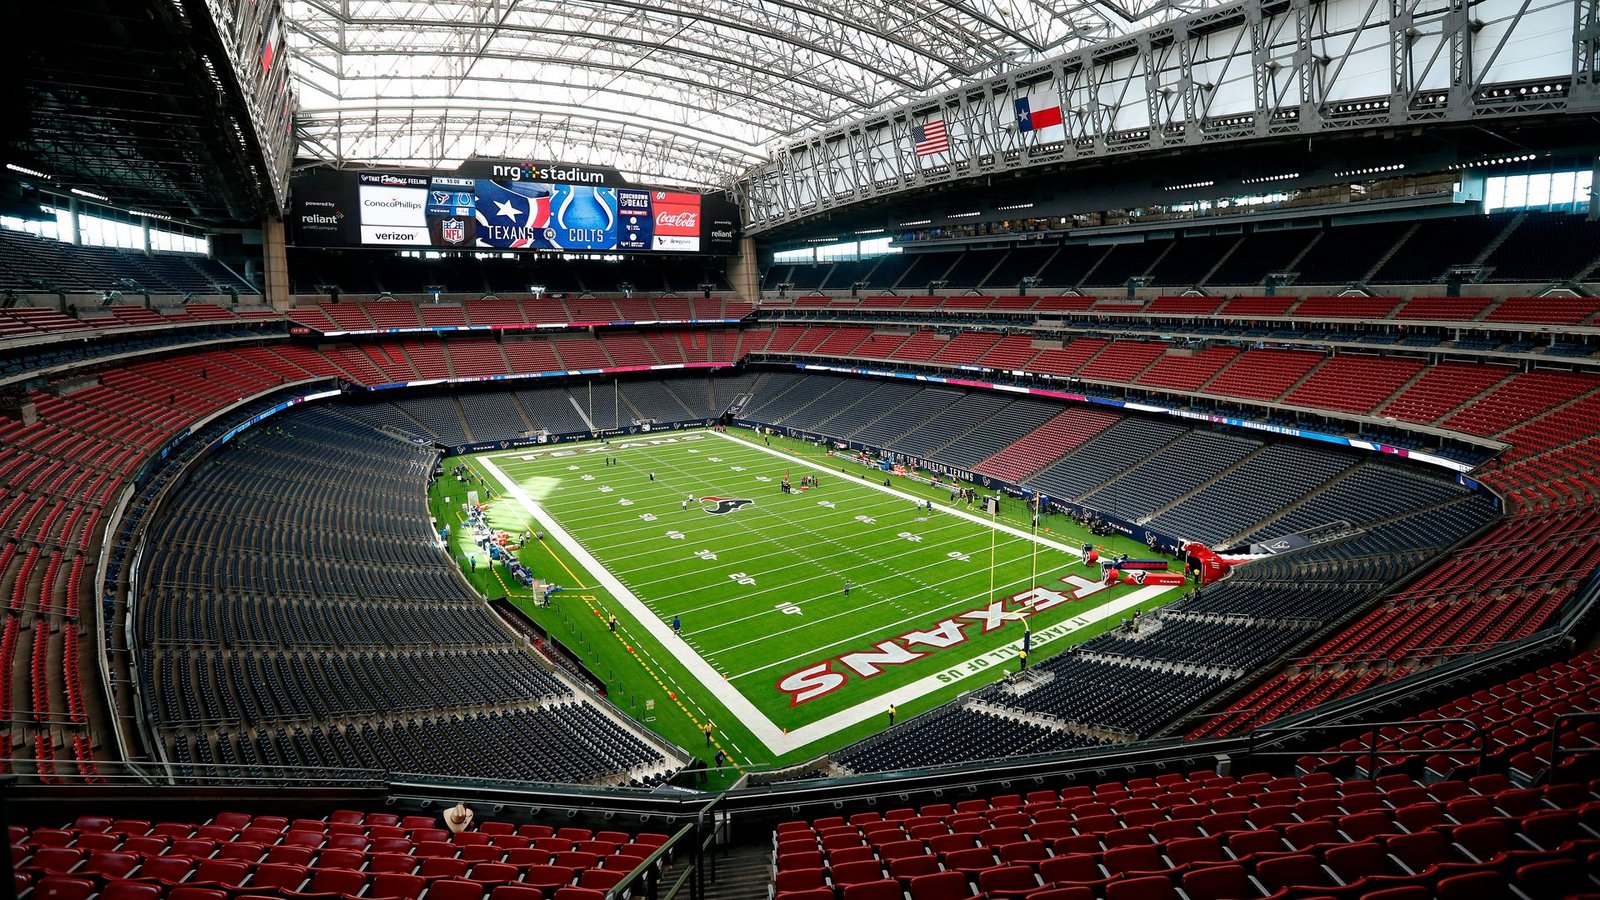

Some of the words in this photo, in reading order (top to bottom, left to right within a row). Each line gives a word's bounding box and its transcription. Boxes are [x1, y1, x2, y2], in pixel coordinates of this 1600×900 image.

[493, 165, 521, 181] nrg
[540, 167, 604, 183] stadium
[364, 199, 422, 210] ConocoPhillips
[302, 213, 338, 224] reliant
[375, 231, 414, 240] verizon
[445, 228, 462, 240] NFL
[487, 225, 534, 241] TEXANS
[569, 228, 604, 242] COLTS
[711, 229, 733, 238] reliant
[1242, 421, 1280, 433] INDIANAPOLIS
[1281, 427, 1300, 437] COLTS
[920, 459, 947, 475] HOUSTON
[950, 467, 974, 482] TEXANS
[1107, 521, 1133, 535] TEXANS
[728, 572, 755, 586] 20
[1071, 616, 1090, 628] IT
[775, 573, 1121, 708] TEXANS
[967, 658, 990, 672] OF
[936, 670, 964, 683] US
